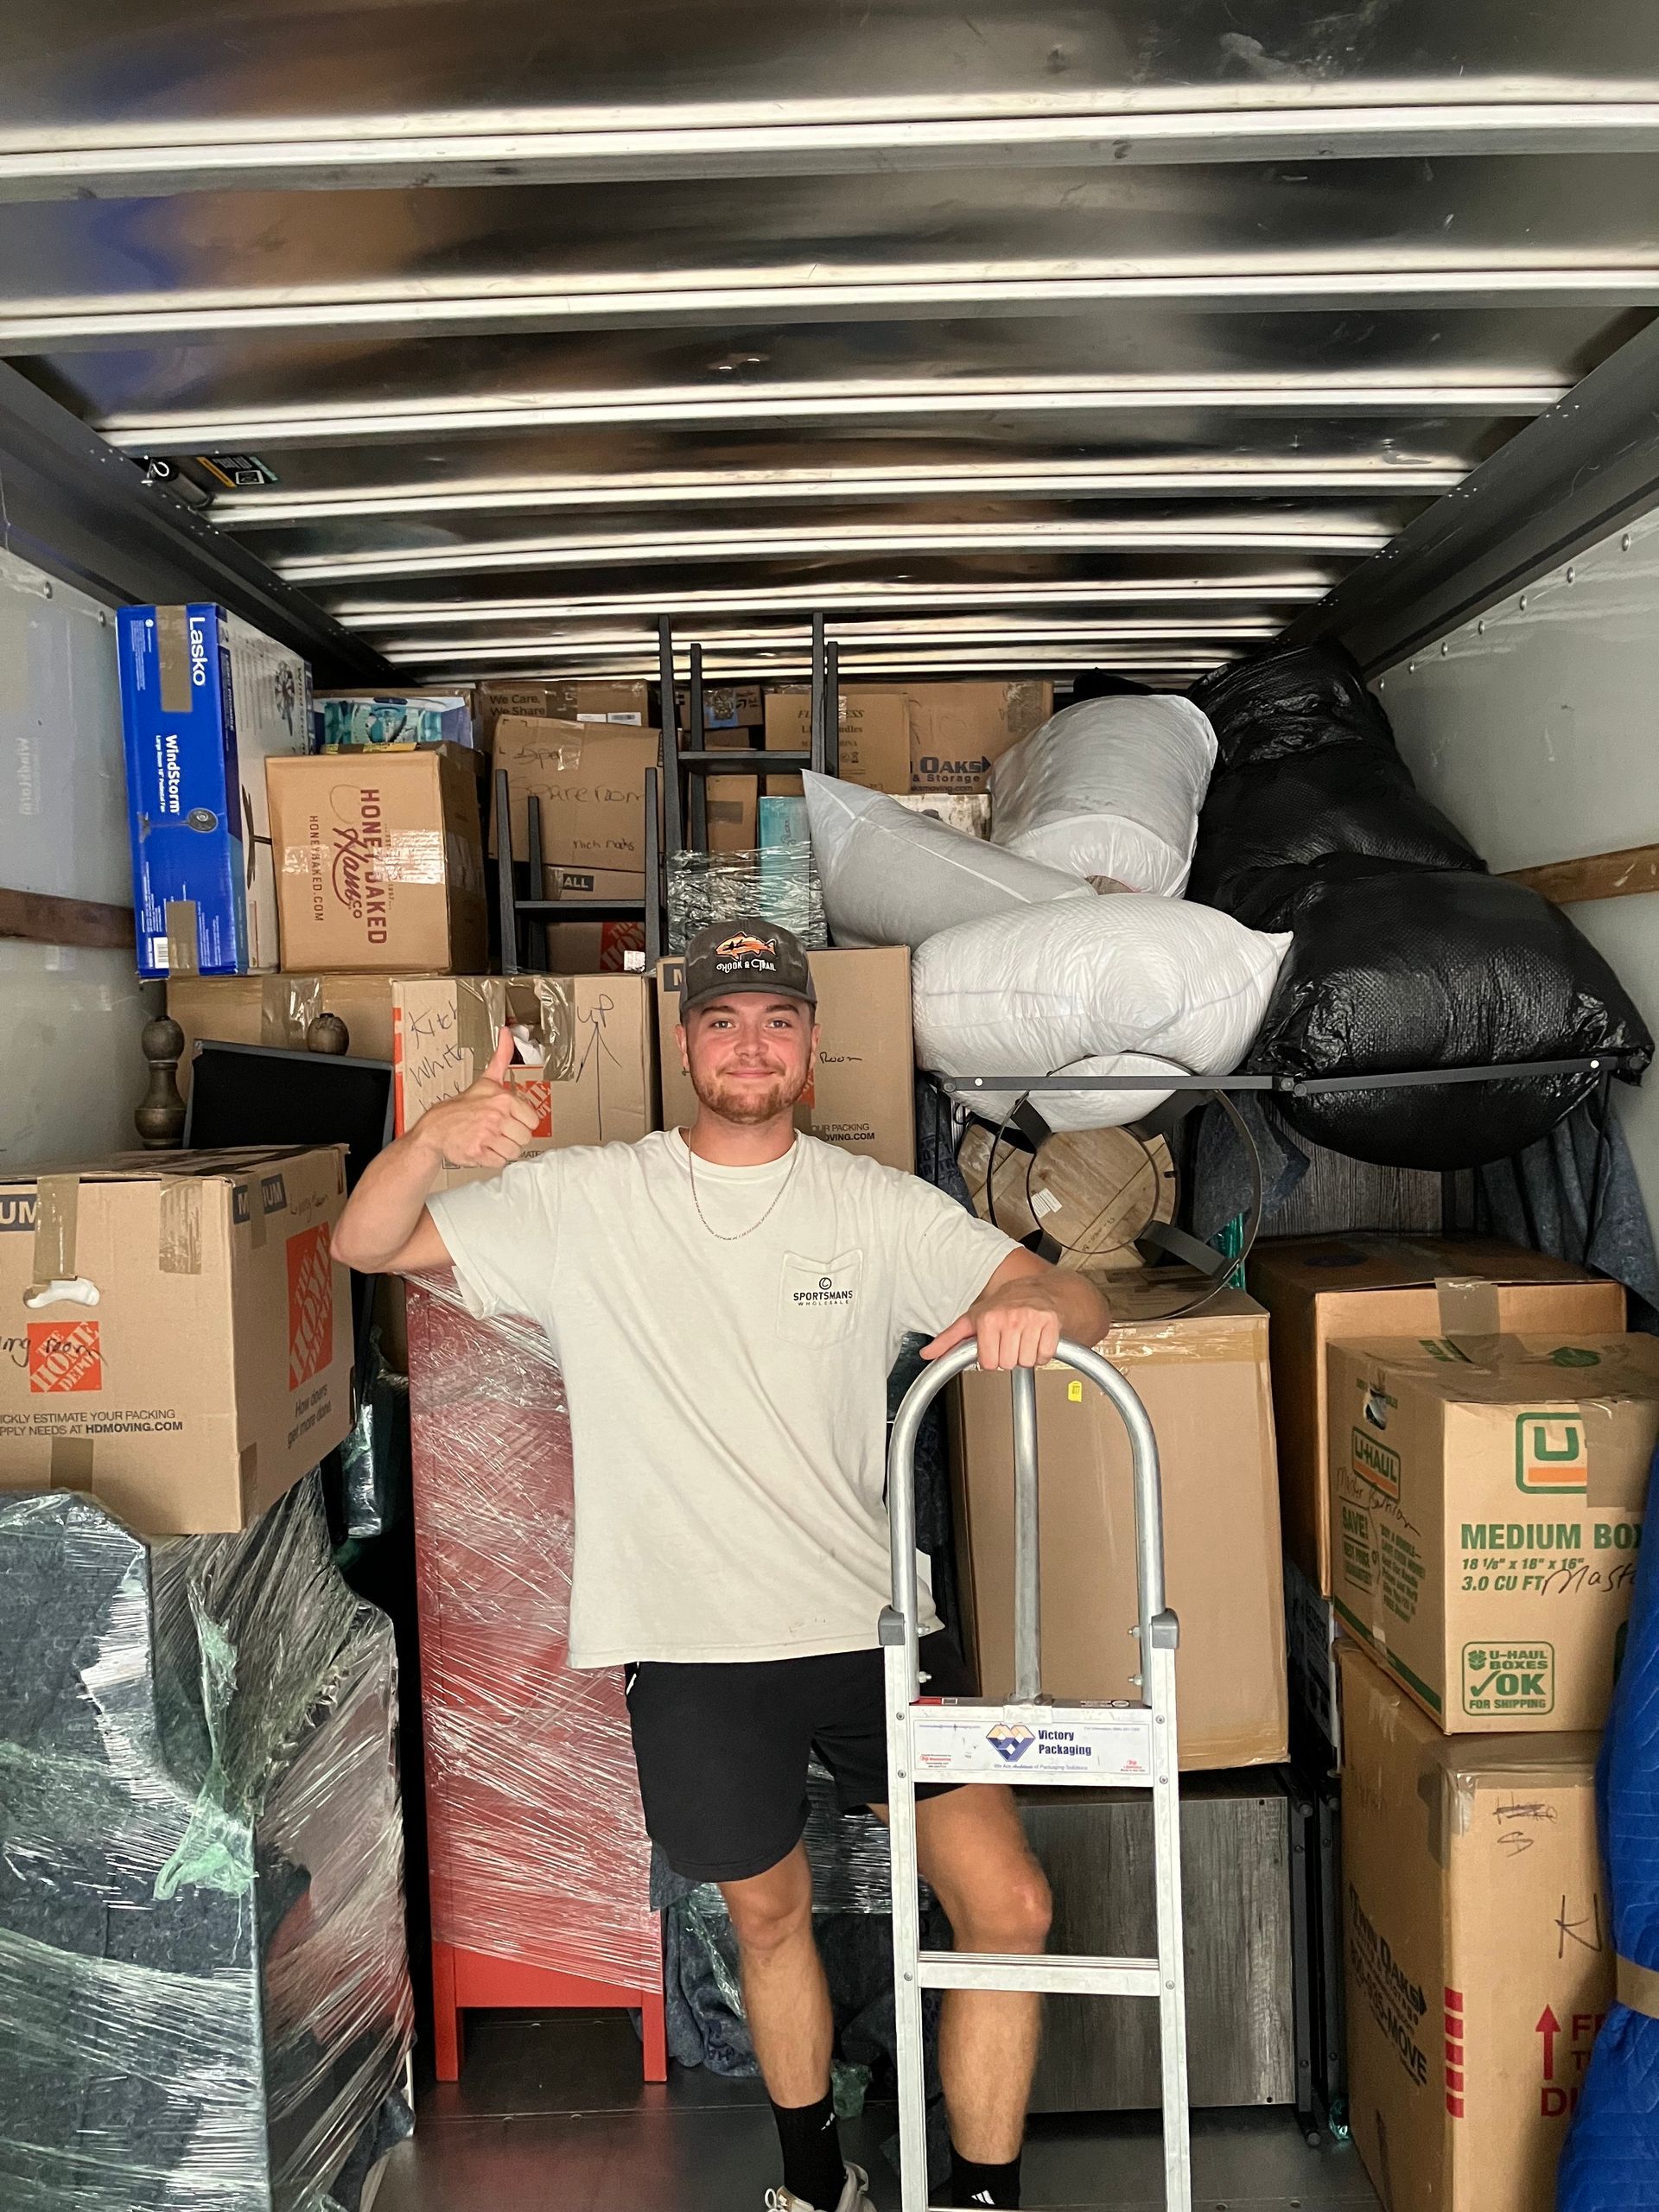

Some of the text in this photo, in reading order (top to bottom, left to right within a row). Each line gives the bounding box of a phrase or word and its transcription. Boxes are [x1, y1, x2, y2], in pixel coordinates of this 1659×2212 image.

[190, 617, 207, 686] Lasko
[490, 696, 508, 704] We
[512, 707, 545, 716] Share
[920, 757, 982, 773] OAKS
[166, 734, 181, 814] WindStorm
[927, 774, 980, 783] Storage
[309, 815, 325, 921] HONEYBAKED.COM
[831, 1123, 870, 1132] PACKING
[793, 1290, 854, 1301] SPORTSMANS
[30, 1321, 99, 1393] HOME
[34, 1412, 87, 1424] ESTIMATE
[90, 1411, 123, 1422] YOUR
[126, 1409, 176, 1421] PACKING
[29, 1426, 67, 1436] NEEDS
[69, 1425, 83, 1435] AT
[86, 1421, 183, 1434] HDMOVING.COM
[1354, 1434, 1397, 1484] U-HAUL
[1461, 1523, 1581, 1549] MEDIUM
[1462, 1558, 1478, 1570] 18
[1510, 1560, 1517, 1570] x
[1548, 1560, 1556, 1570] x
[1462, 1575, 1489, 1591] 3.0
[1494, 1575, 1517, 1591] CU
[1490, 1649, 1548, 1659] U-HAUL
[1490, 1660, 1548, 1669] BOXES
[1496, 1673, 1547, 1696] OK
[1469, 1699, 1547, 1709] FOR SHIPPING
[1038, 1730, 1074, 1742] Victory
[1039, 1744, 1092, 1757] Packaging
